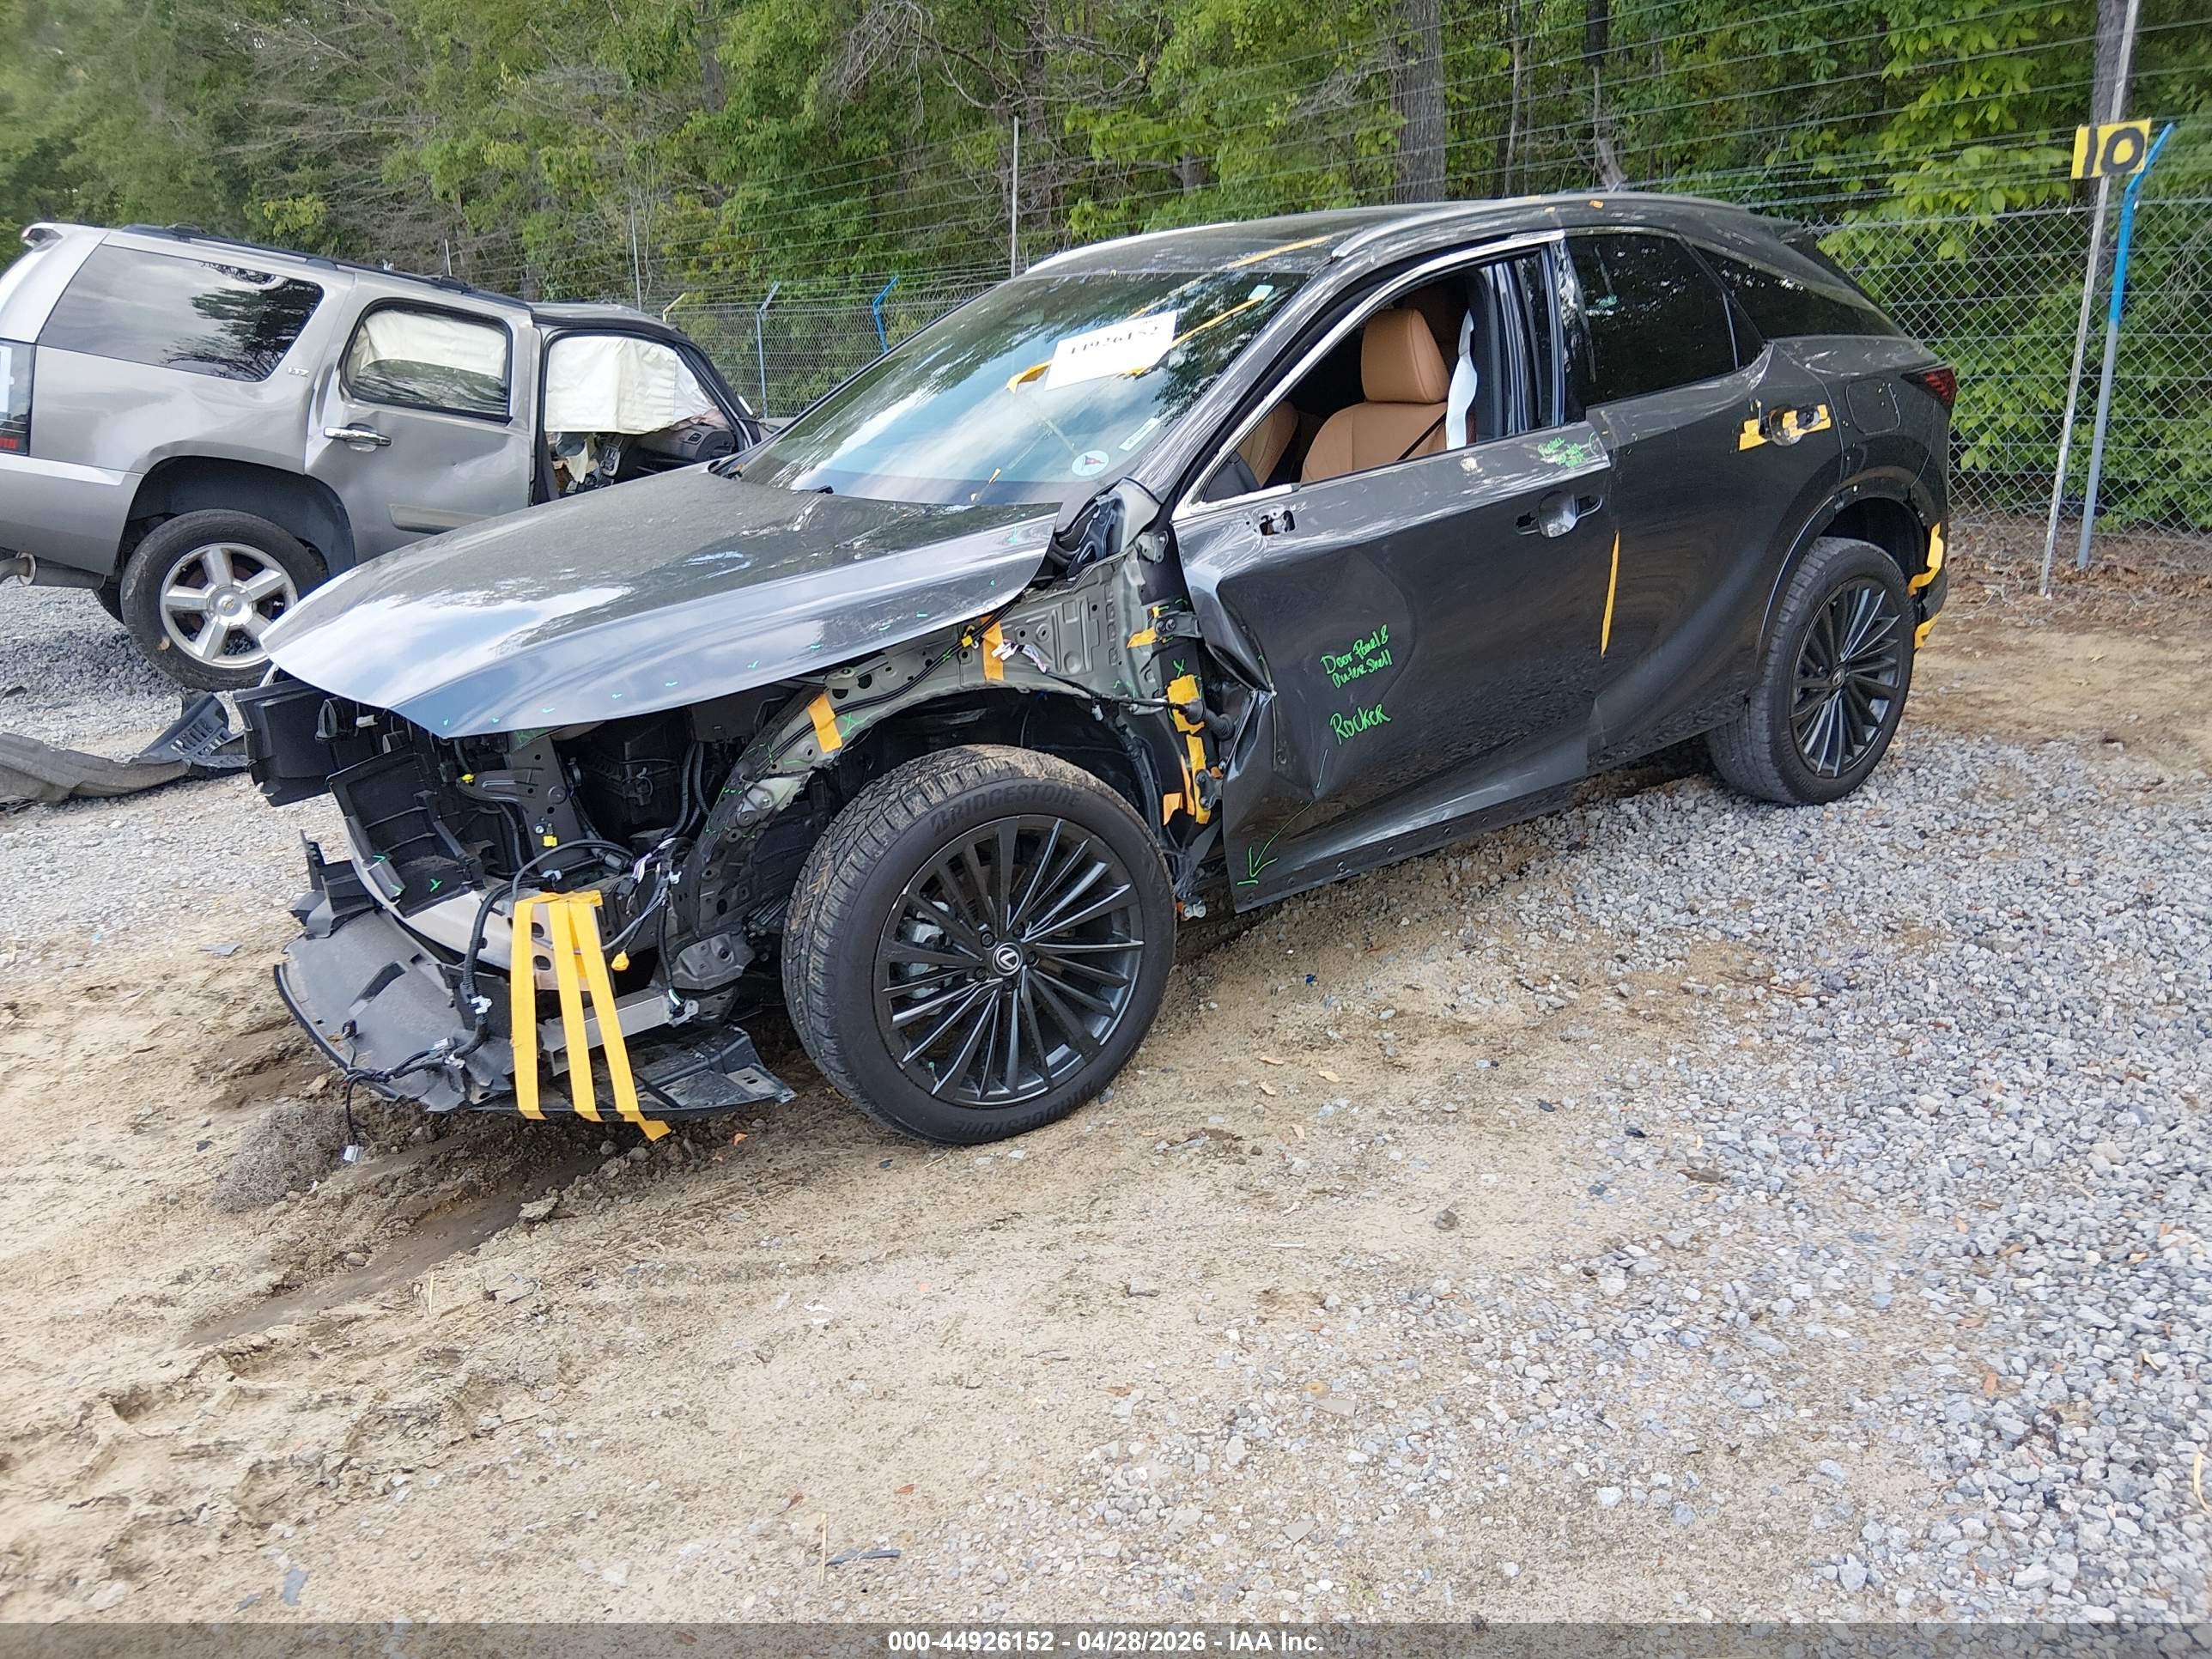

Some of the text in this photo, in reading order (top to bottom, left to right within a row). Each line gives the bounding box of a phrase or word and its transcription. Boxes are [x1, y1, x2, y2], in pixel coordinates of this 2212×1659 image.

[2082, 125, 2145, 179] 10
[288, 367, 310, 378] LTZ
[1319, 652, 1353, 674] Door
[1352, 630, 1382, 659] Panel
[930, 783, 1084, 836] BRIDGESTONE
